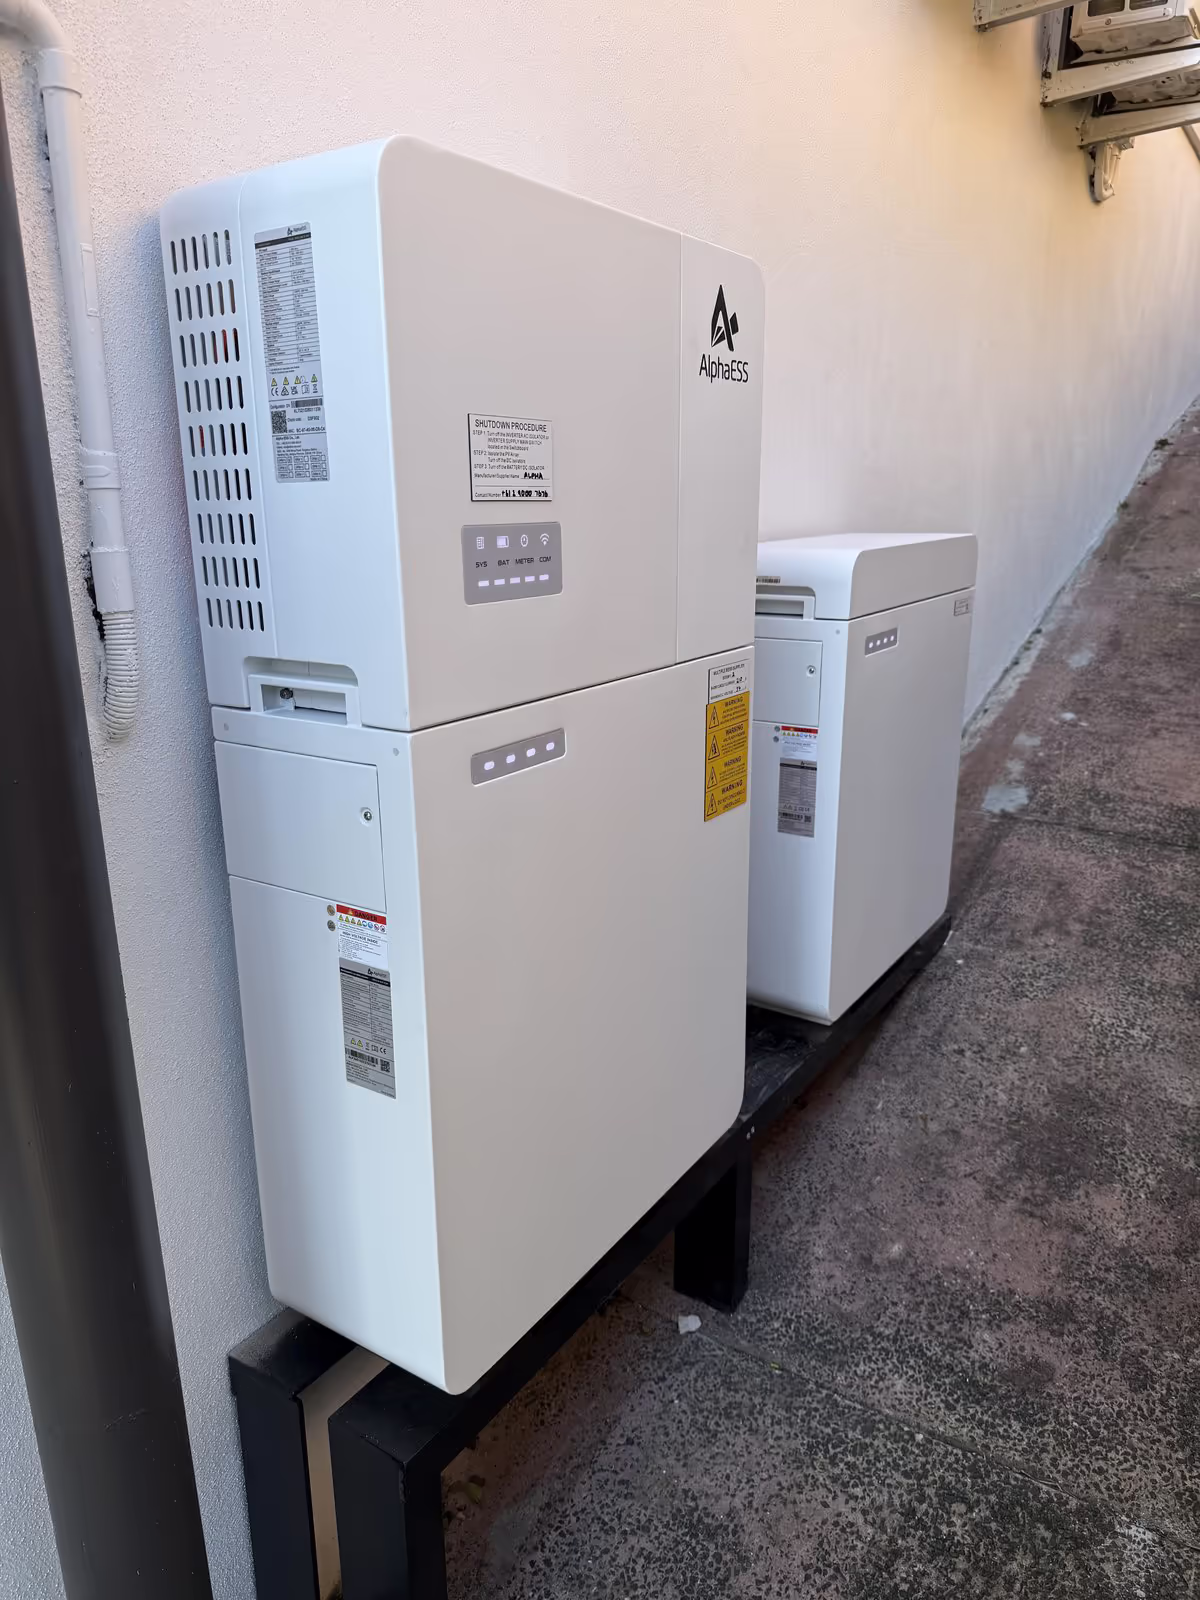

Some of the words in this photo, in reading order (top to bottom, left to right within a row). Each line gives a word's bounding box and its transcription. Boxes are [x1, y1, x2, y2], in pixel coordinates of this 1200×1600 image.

[699, 353, 749, 383] AlphaESS
[474, 419, 510, 430] SHUTDOWN
[511, 421, 547, 433] PROCEDURE
[523, 472, 543, 480] ALPHA
[497, 559, 510, 567] BAT
[515, 557, 534, 565] METER
[724, 696, 744, 707] WARNING
[725, 724, 744, 736] WARNING
[724, 756, 742, 768] WARNING
[721, 779, 743, 794] WARNING
[354, 910, 378, 922] DANGER
